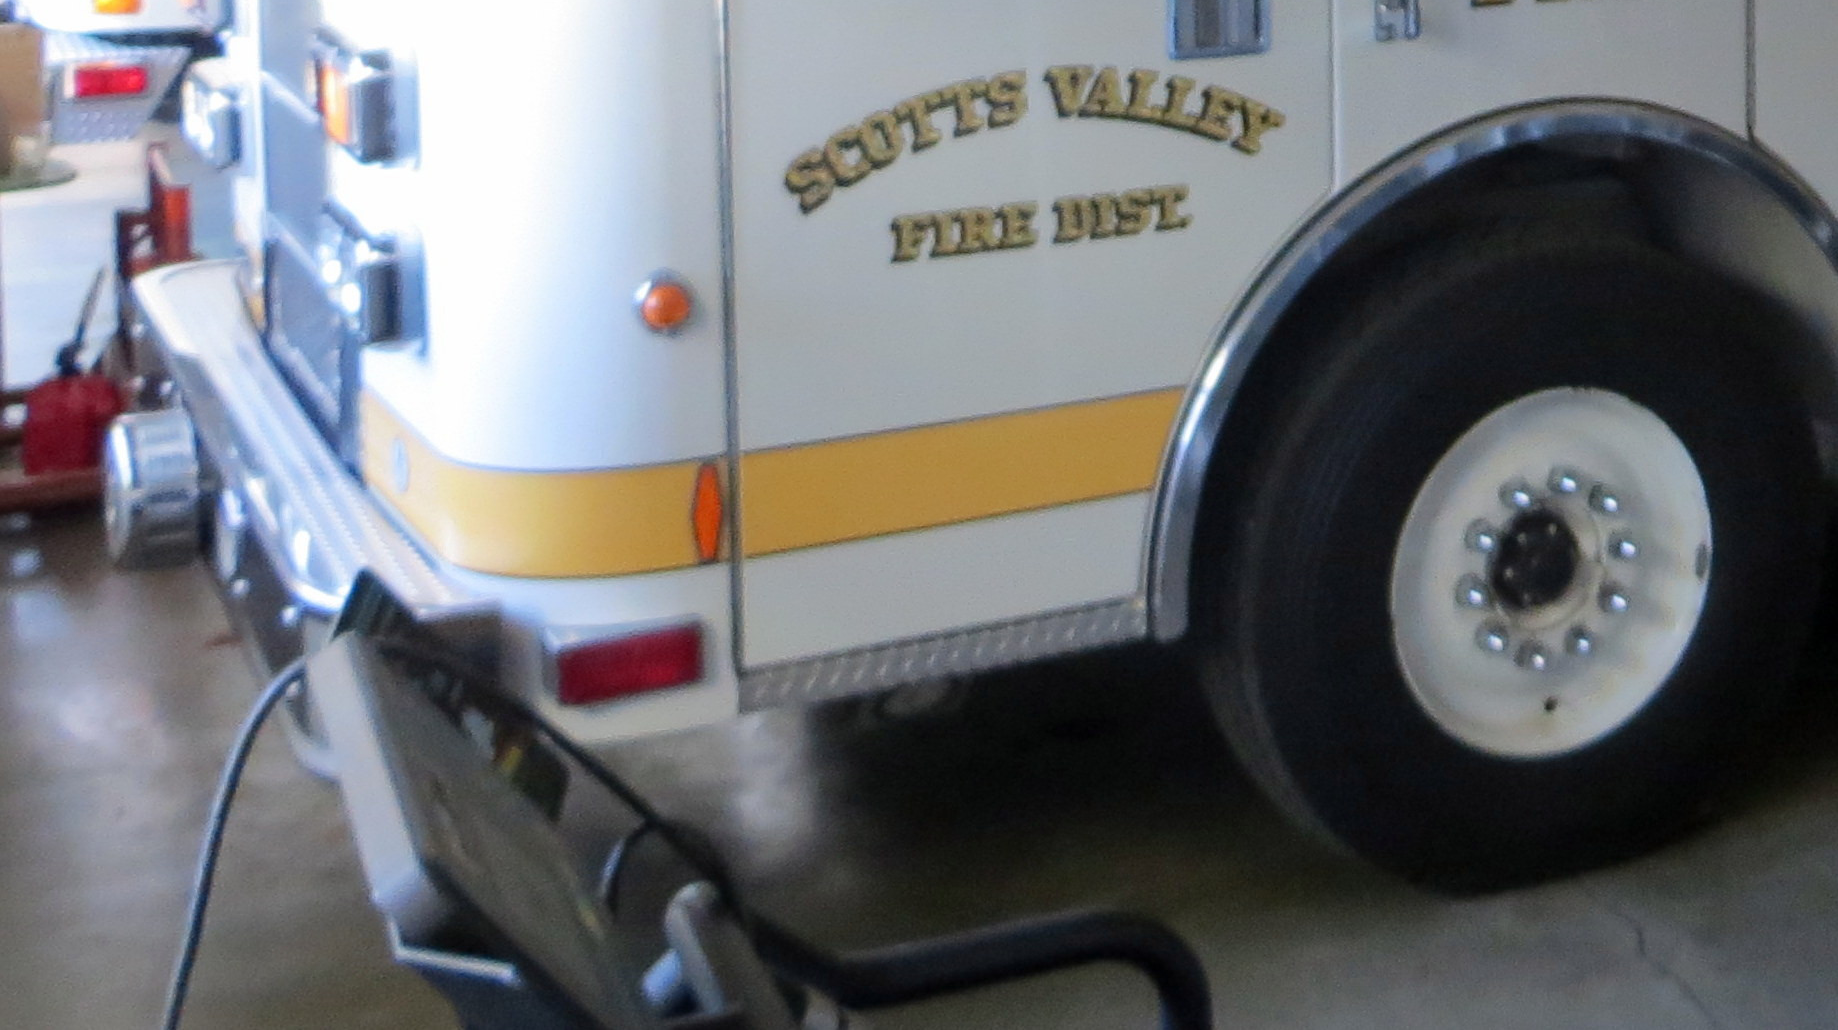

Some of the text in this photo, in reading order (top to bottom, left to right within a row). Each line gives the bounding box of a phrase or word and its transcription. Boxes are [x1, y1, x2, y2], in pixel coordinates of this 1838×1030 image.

[784, 65, 1286, 215] SCOTTS VALLEY
[891, 200, 1040, 263] FIRE
